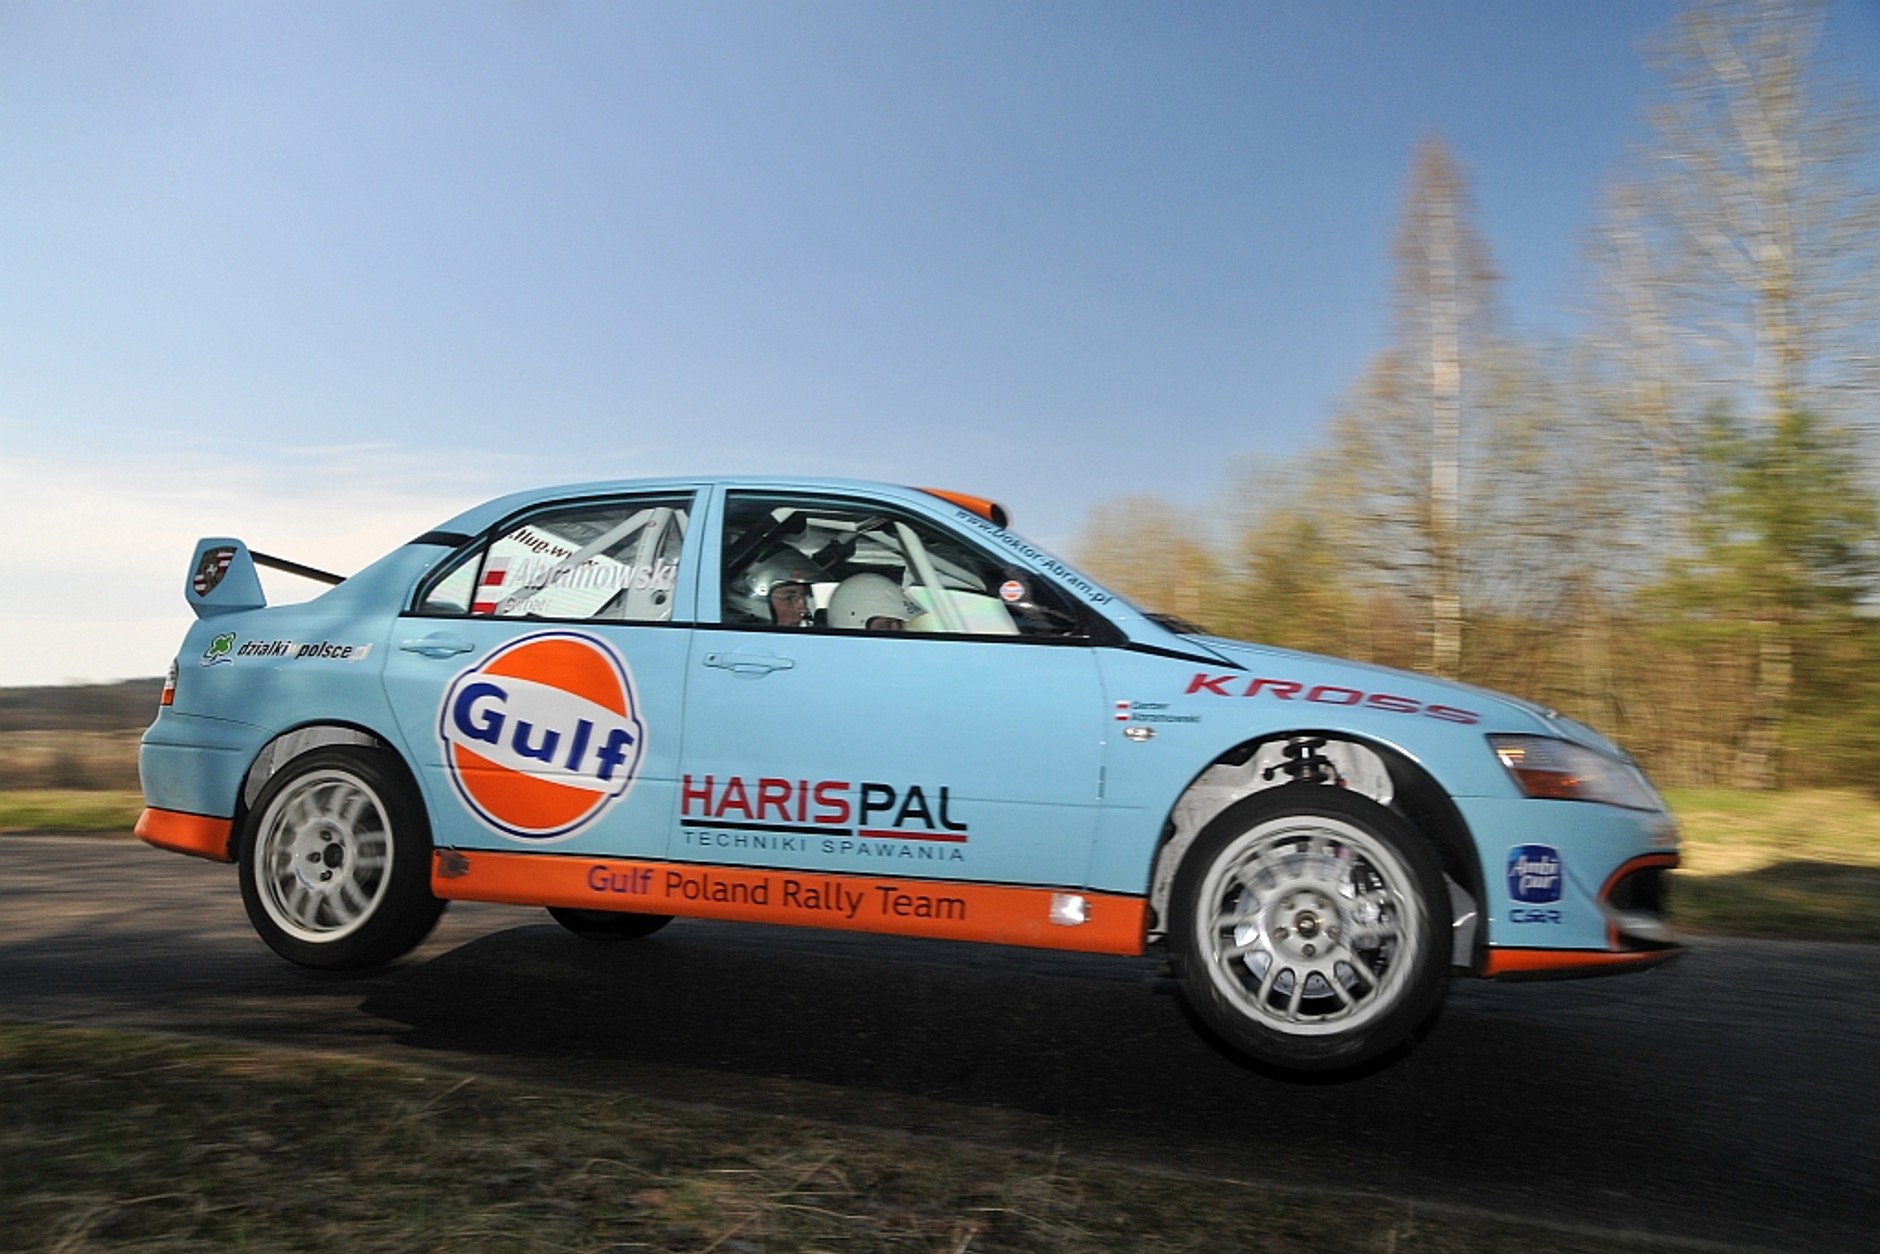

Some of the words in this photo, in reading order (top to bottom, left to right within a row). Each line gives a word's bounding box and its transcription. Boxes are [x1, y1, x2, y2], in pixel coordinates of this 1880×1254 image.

[956, 510, 1114, 606] www.Doktor-Abram.pl
[1184, 673, 1482, 725] KROSS
[453, 682, 635, 782] Gulf
[684, 831, 807, 852] TECHNIKI
[822, 840, 965, 862] SPAWANIA
[588, 864, 654, 895] Gulf
[664, 871, 769, 906] Poland
[783, 879, 864, 919] Rally
[874, 886, 966, 920] Team
[1509, 908, 1562, 925] CAR
